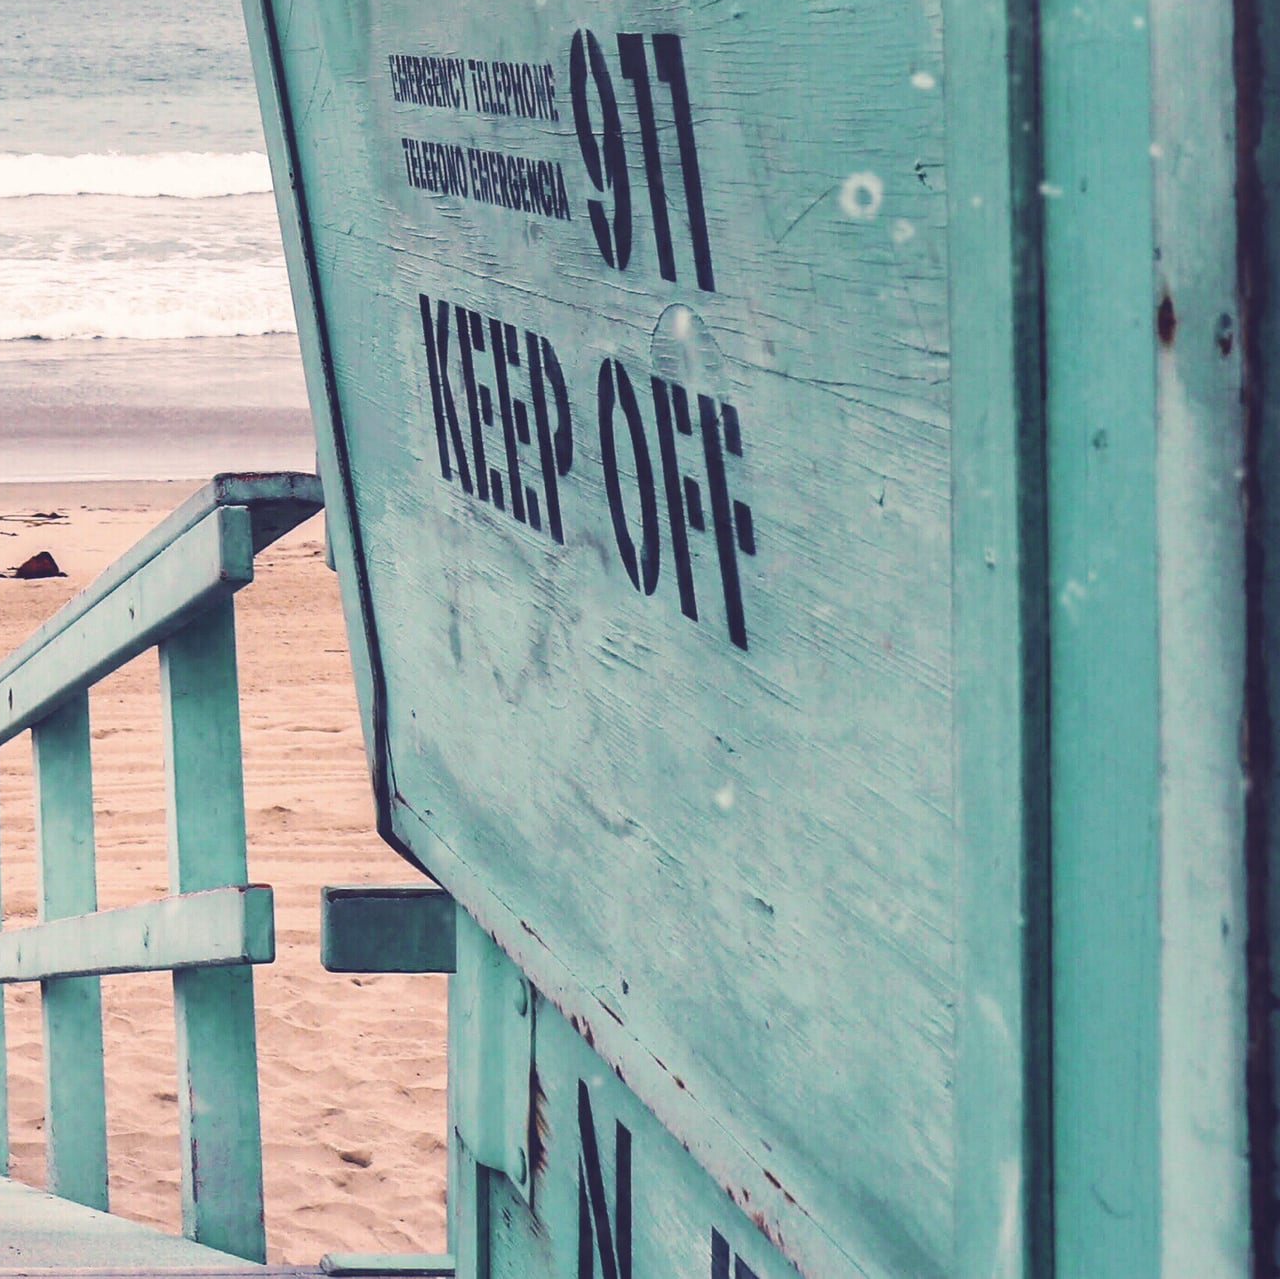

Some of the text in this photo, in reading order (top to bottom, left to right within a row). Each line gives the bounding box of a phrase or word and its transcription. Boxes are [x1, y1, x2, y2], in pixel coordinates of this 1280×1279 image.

[389, 55, 560, 122] EMERGENCY TELEPHONE
[570, 29, 716, 292] 911
[401, 138, 572, 221] TELEFONO EMERGENCIA
[419, 293, 757, 652] KEEP OFF
